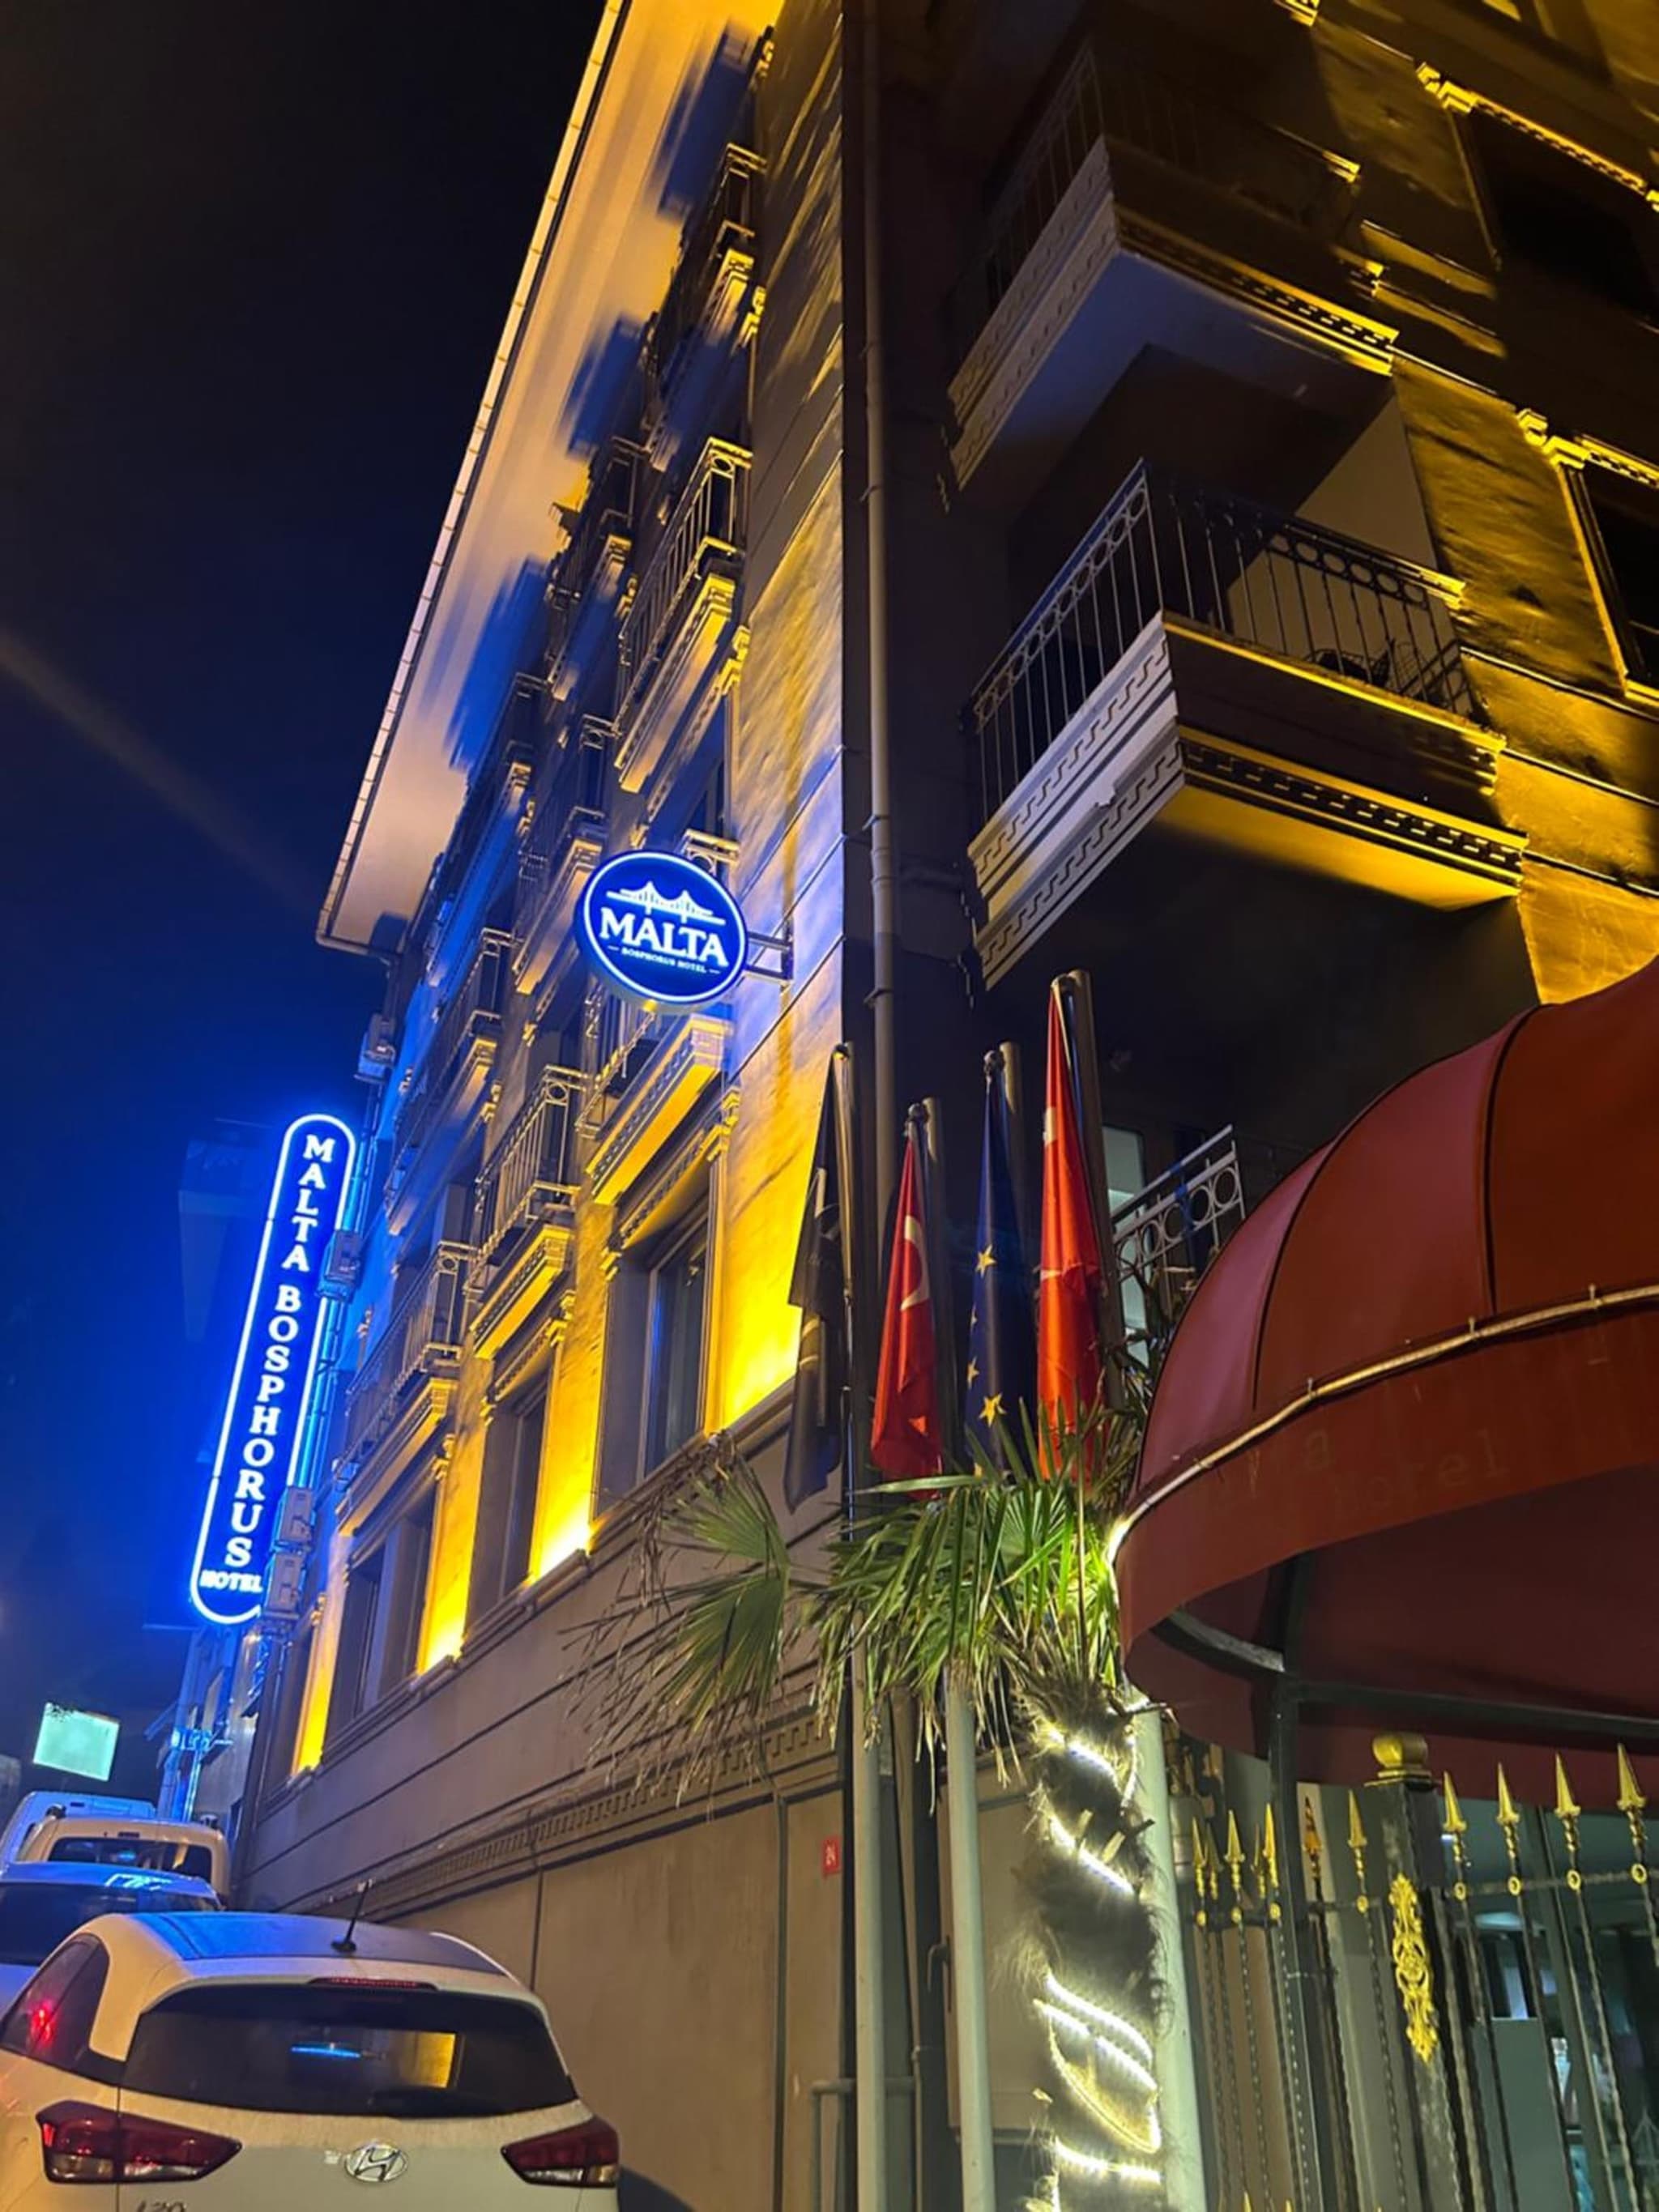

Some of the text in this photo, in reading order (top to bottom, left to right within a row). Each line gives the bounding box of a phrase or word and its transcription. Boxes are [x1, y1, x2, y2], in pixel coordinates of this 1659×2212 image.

[599, 906, 729, 967] MALTA
[224, 1134, 335, 1567] MALTA BOSPHORUS
[199, 1570, 263, 1593] HOTEL
